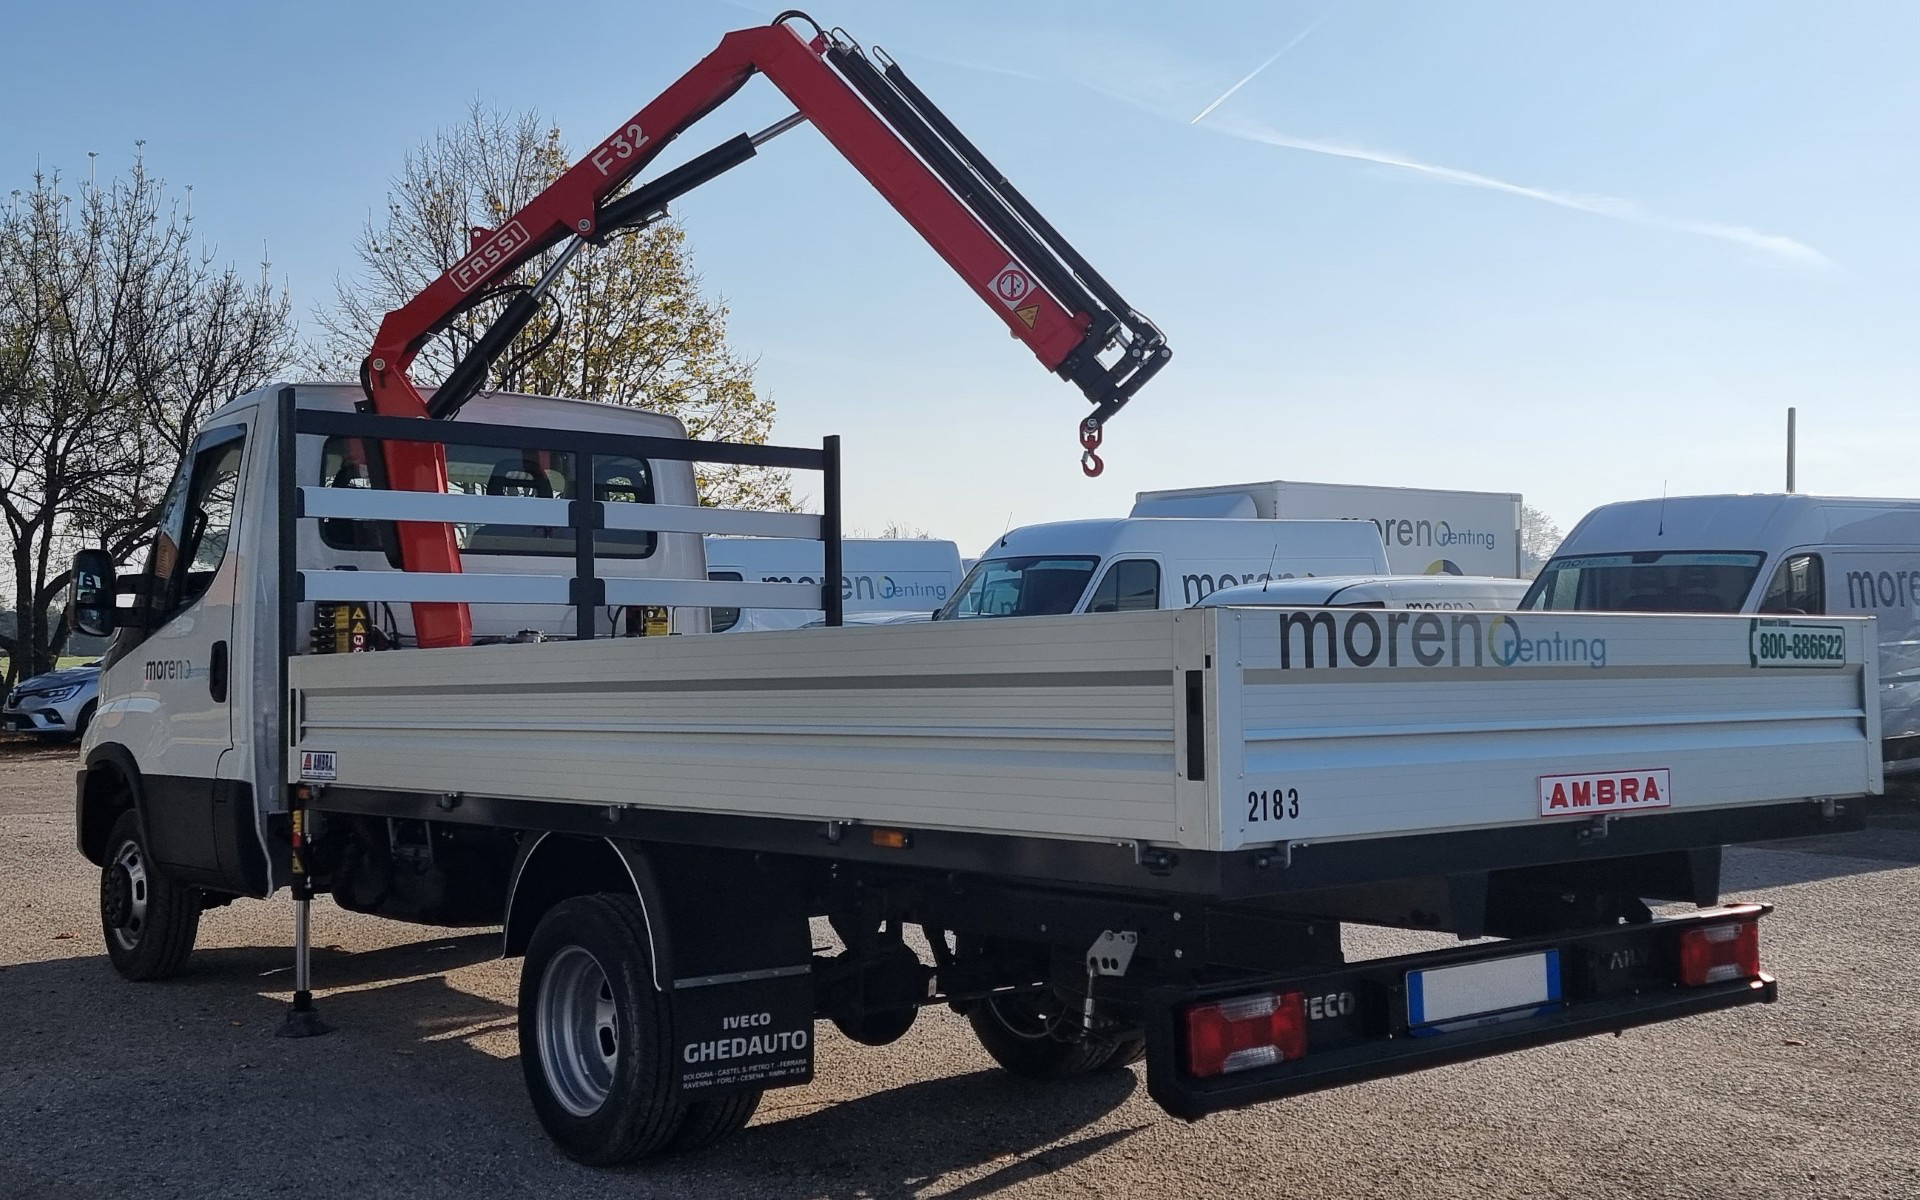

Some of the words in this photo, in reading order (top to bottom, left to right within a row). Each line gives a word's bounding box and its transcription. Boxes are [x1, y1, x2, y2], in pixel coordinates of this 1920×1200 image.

[591, 123, 649, 176] F32
[458, 228, 522, 284] FASSI
[1442, 529, 1495, 550] renting
[886, 582, 946, 600] renting
[1279, 611, 1522, 670] moreno
[1503, 631, 1607, 669] renting
[1760, 632, 1844, 660] 800-886622
[1247, 788, 1300, 822] 2183
[1549, 776, 1661, 809] AMBRA
[723, 1012, 771, 1030] IVECO
[1303, 992, 1355, 1021] ECO
[683, 1030, 808, 1064] GHEDAUTO
[717, 1067, 741, 1077] CASTEL
[780, 1058, 807, 1068] FERRARA
[682, 1079, 713, 1090] RAVENNA
